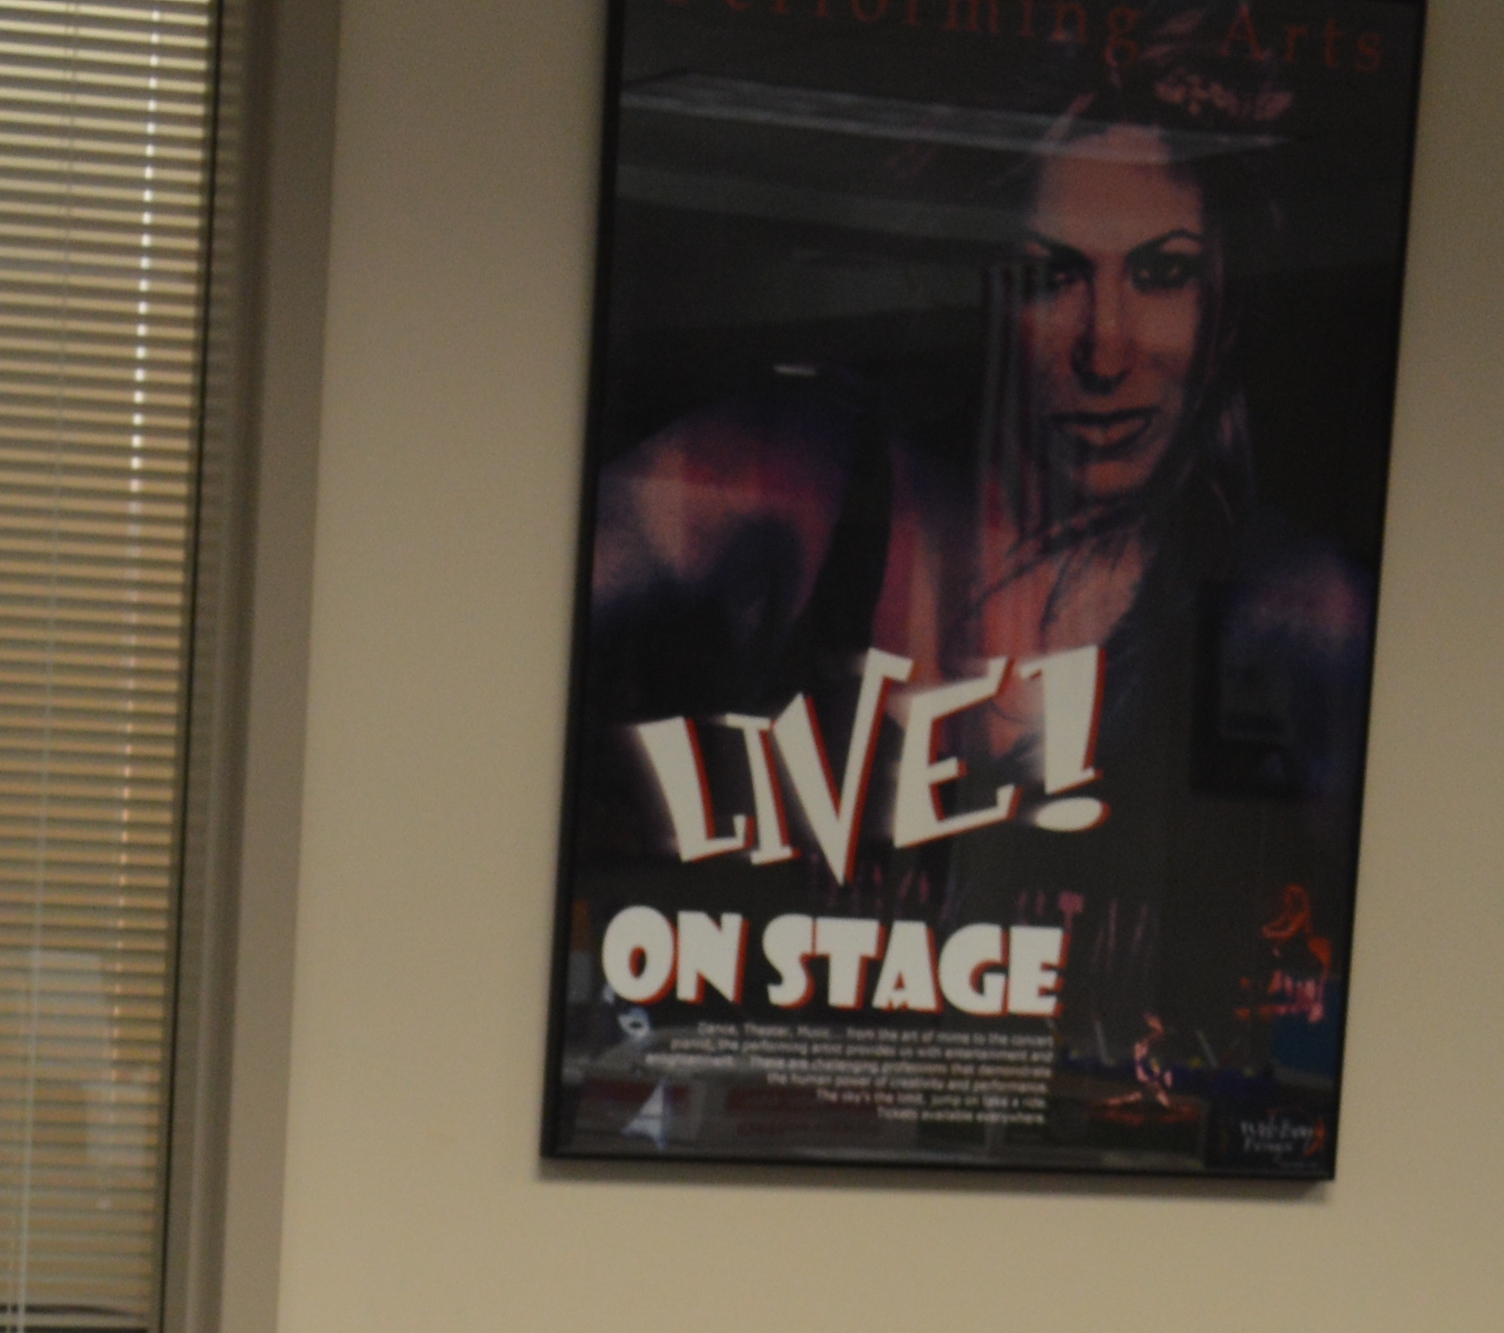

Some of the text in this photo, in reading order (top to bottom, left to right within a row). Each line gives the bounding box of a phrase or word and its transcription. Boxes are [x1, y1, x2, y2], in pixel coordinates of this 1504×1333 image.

[662, 0, 1383, 72] orming Arts
[633, 645, 1109, 886] LIVE!
[600, 905, 1064, 1017] ON STAGE
